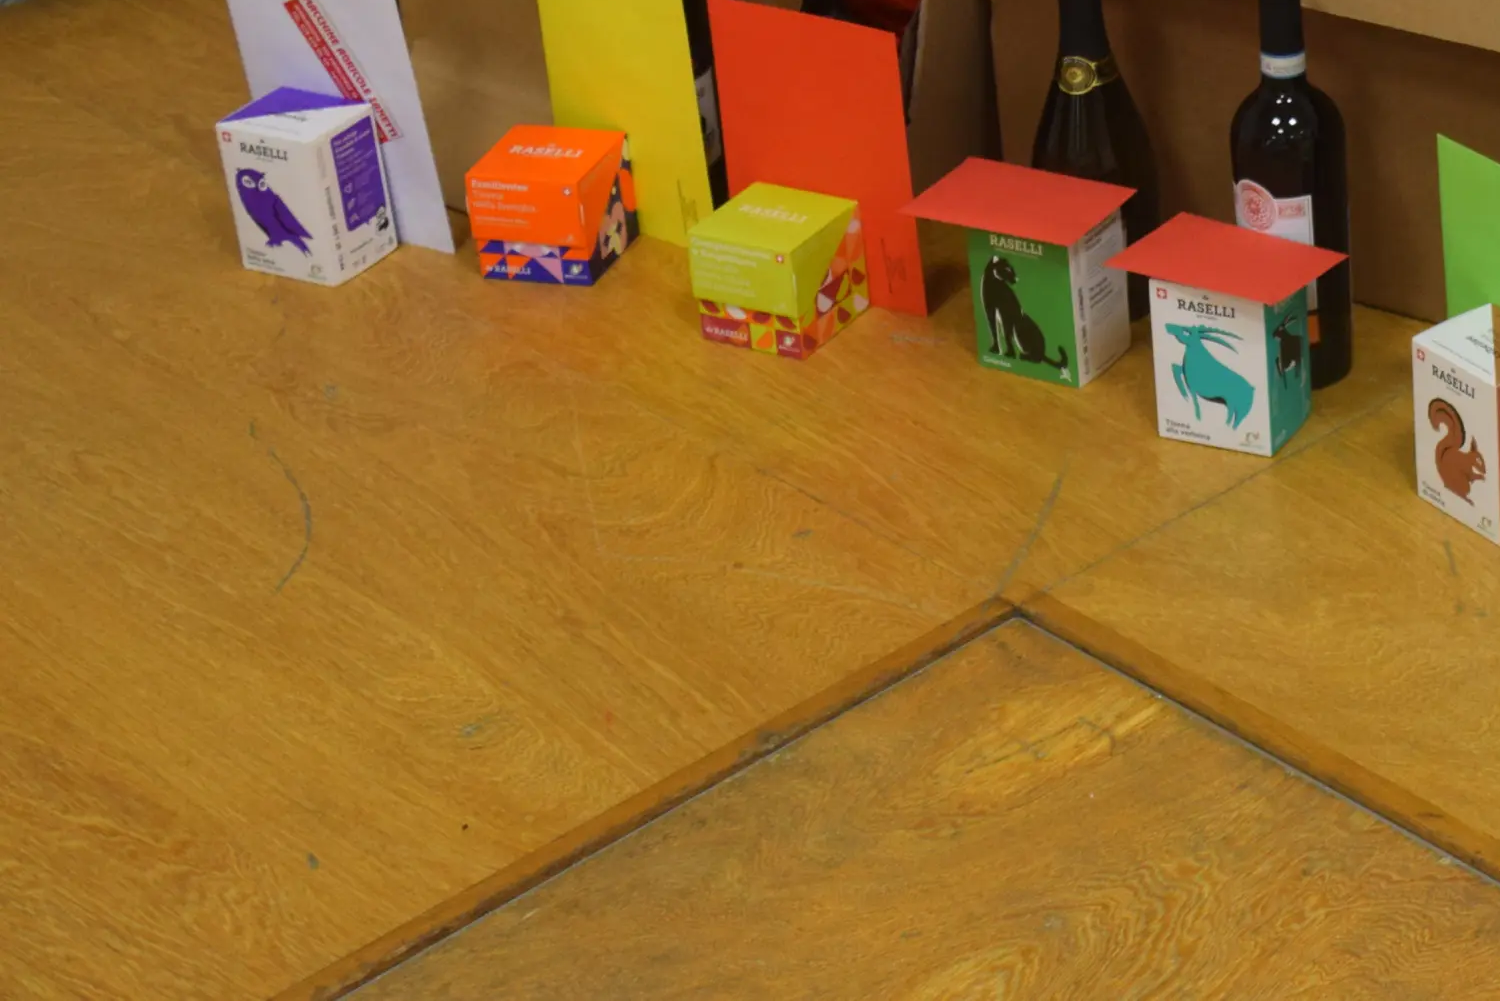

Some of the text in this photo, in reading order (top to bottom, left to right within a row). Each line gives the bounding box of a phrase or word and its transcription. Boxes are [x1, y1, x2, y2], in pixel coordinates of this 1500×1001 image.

[239, 142, 288, 161] RASELLI
[508, 144, 585, 159] RASELLI
[989, 234, 1043, 256] RASELLI
[1177, 298, 1236, 319] RASELLI
[1431, 364, 1476, 399] RASELLI
